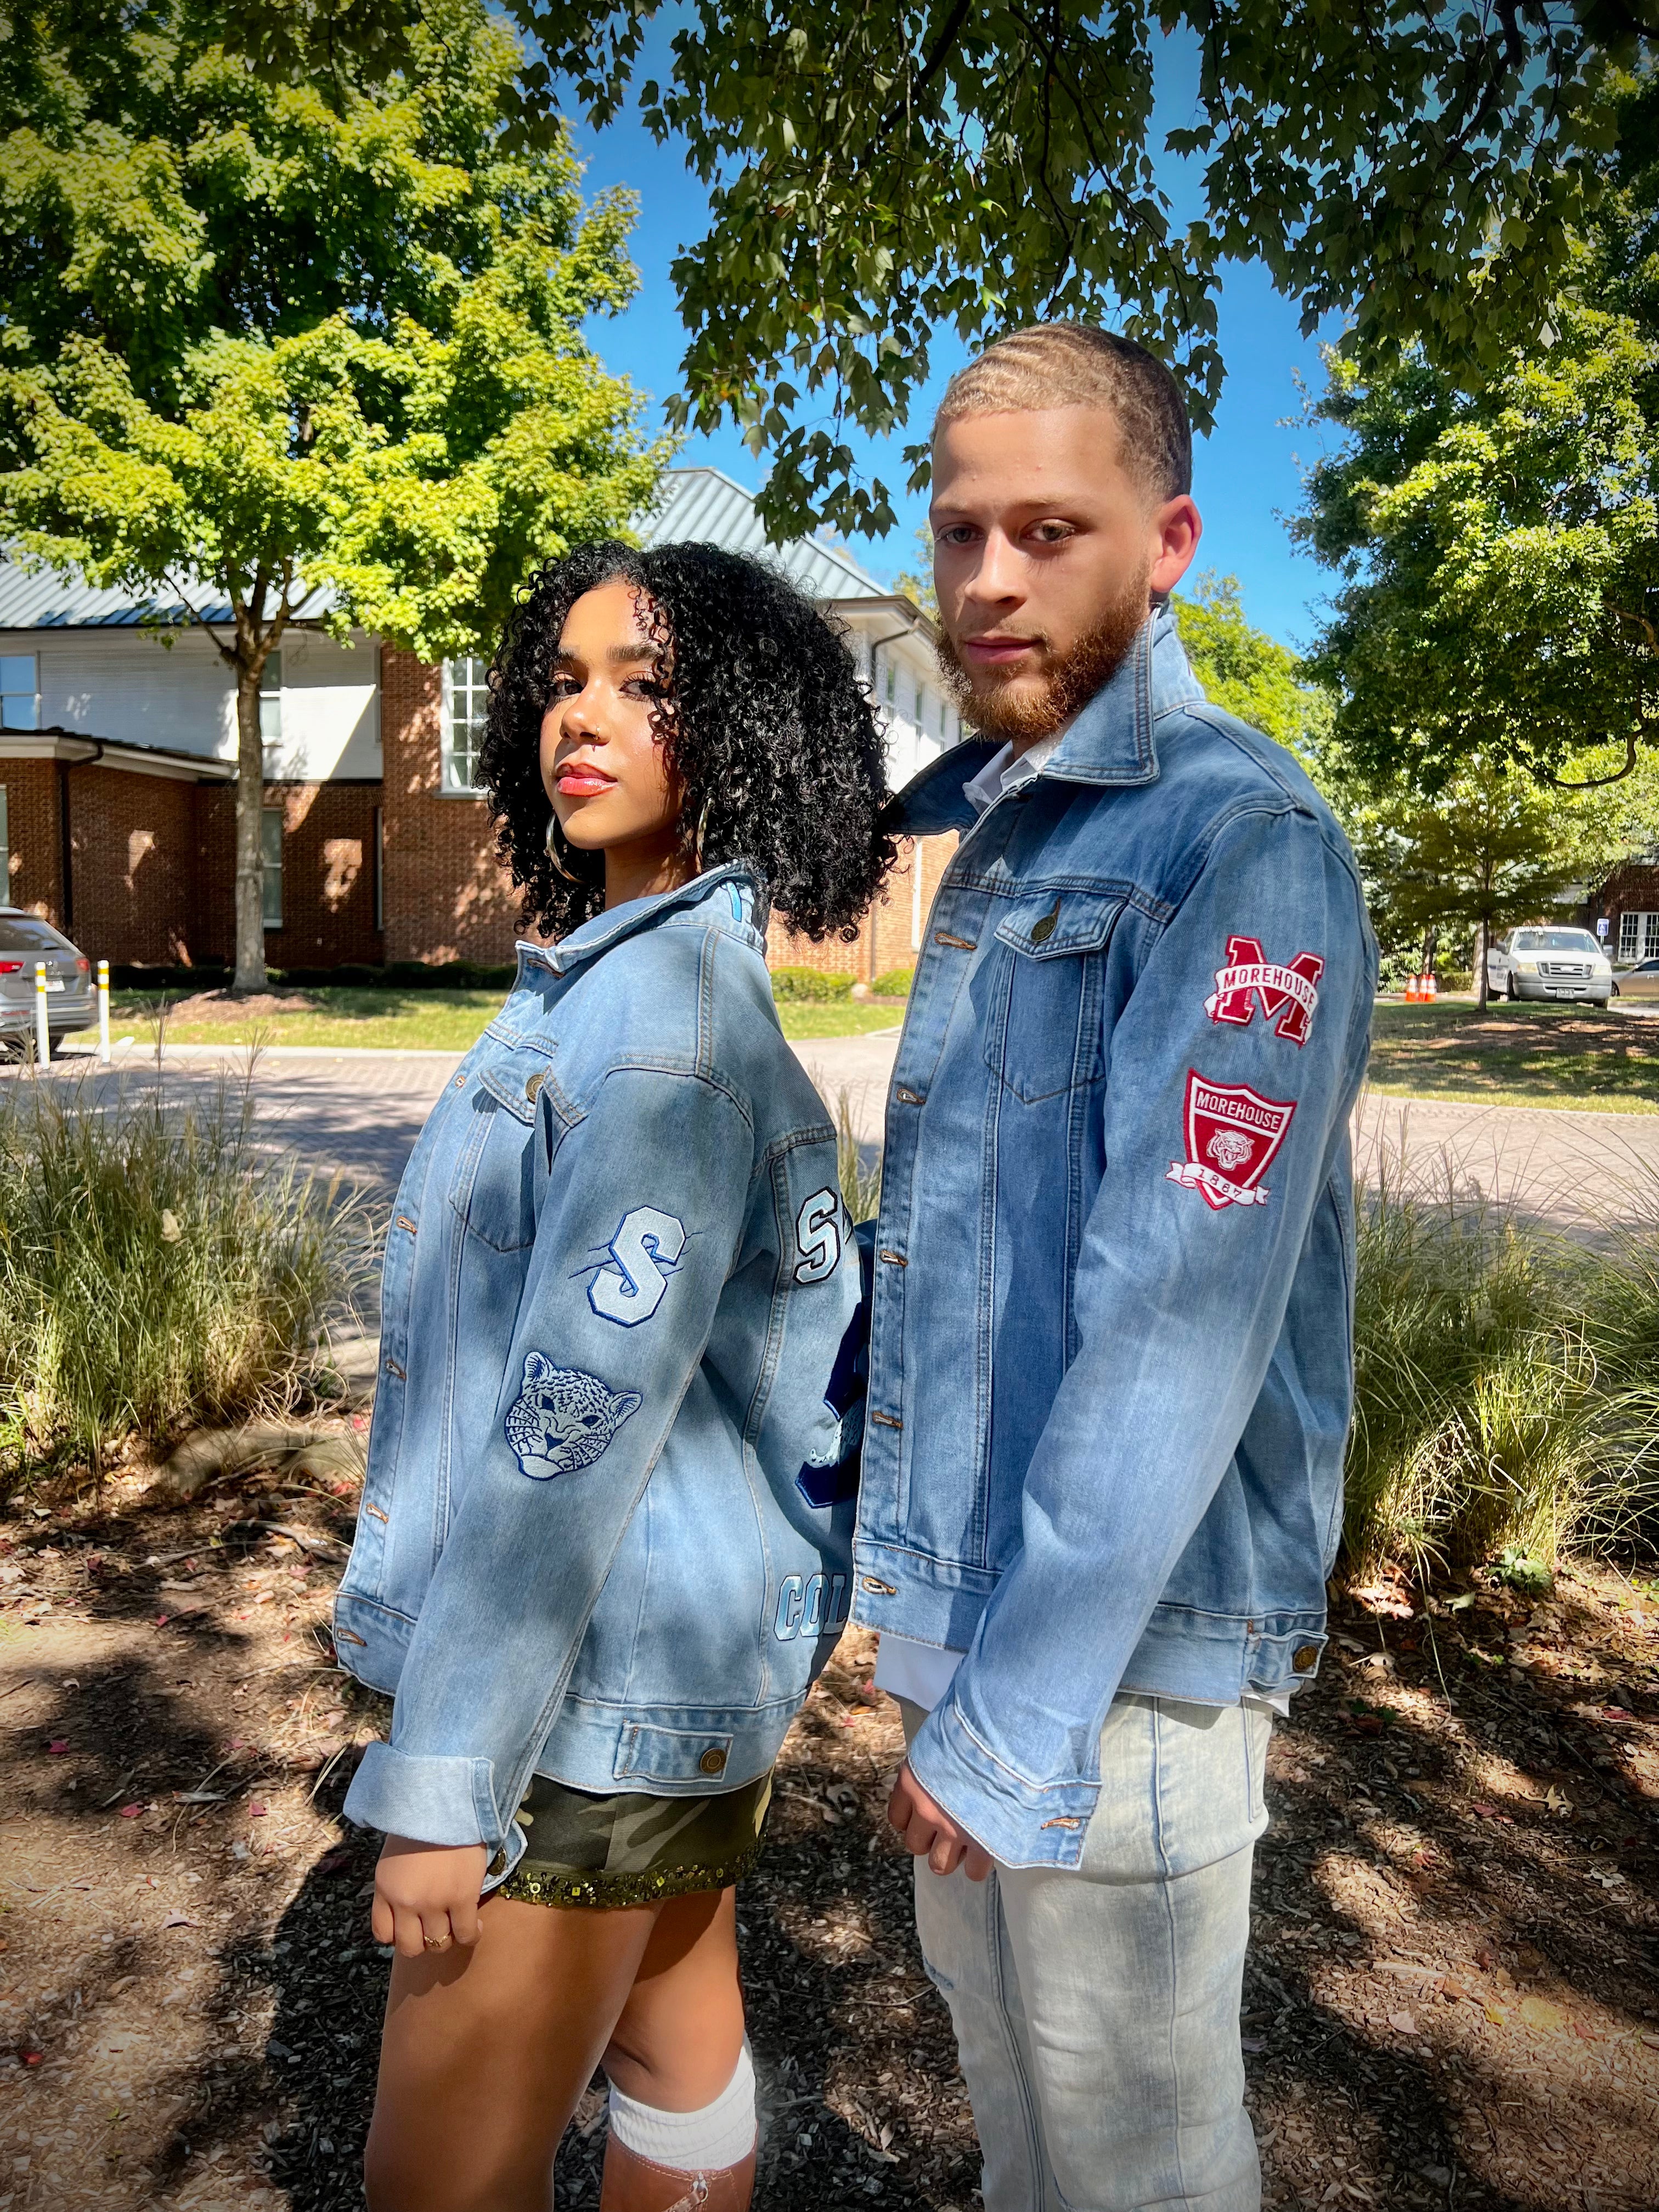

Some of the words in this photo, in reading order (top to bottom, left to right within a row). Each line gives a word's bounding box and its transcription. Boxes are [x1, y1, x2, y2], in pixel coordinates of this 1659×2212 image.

[1223, 967, 1315, 1012] MOREHOUSE
[1197, 1091, 1282, 1130] MOREHOUSE
[1198, 1168, 1242, 1199] 1867
[793, 1186, 853, 1284] S
[587, 1205, 686, 1329] S
